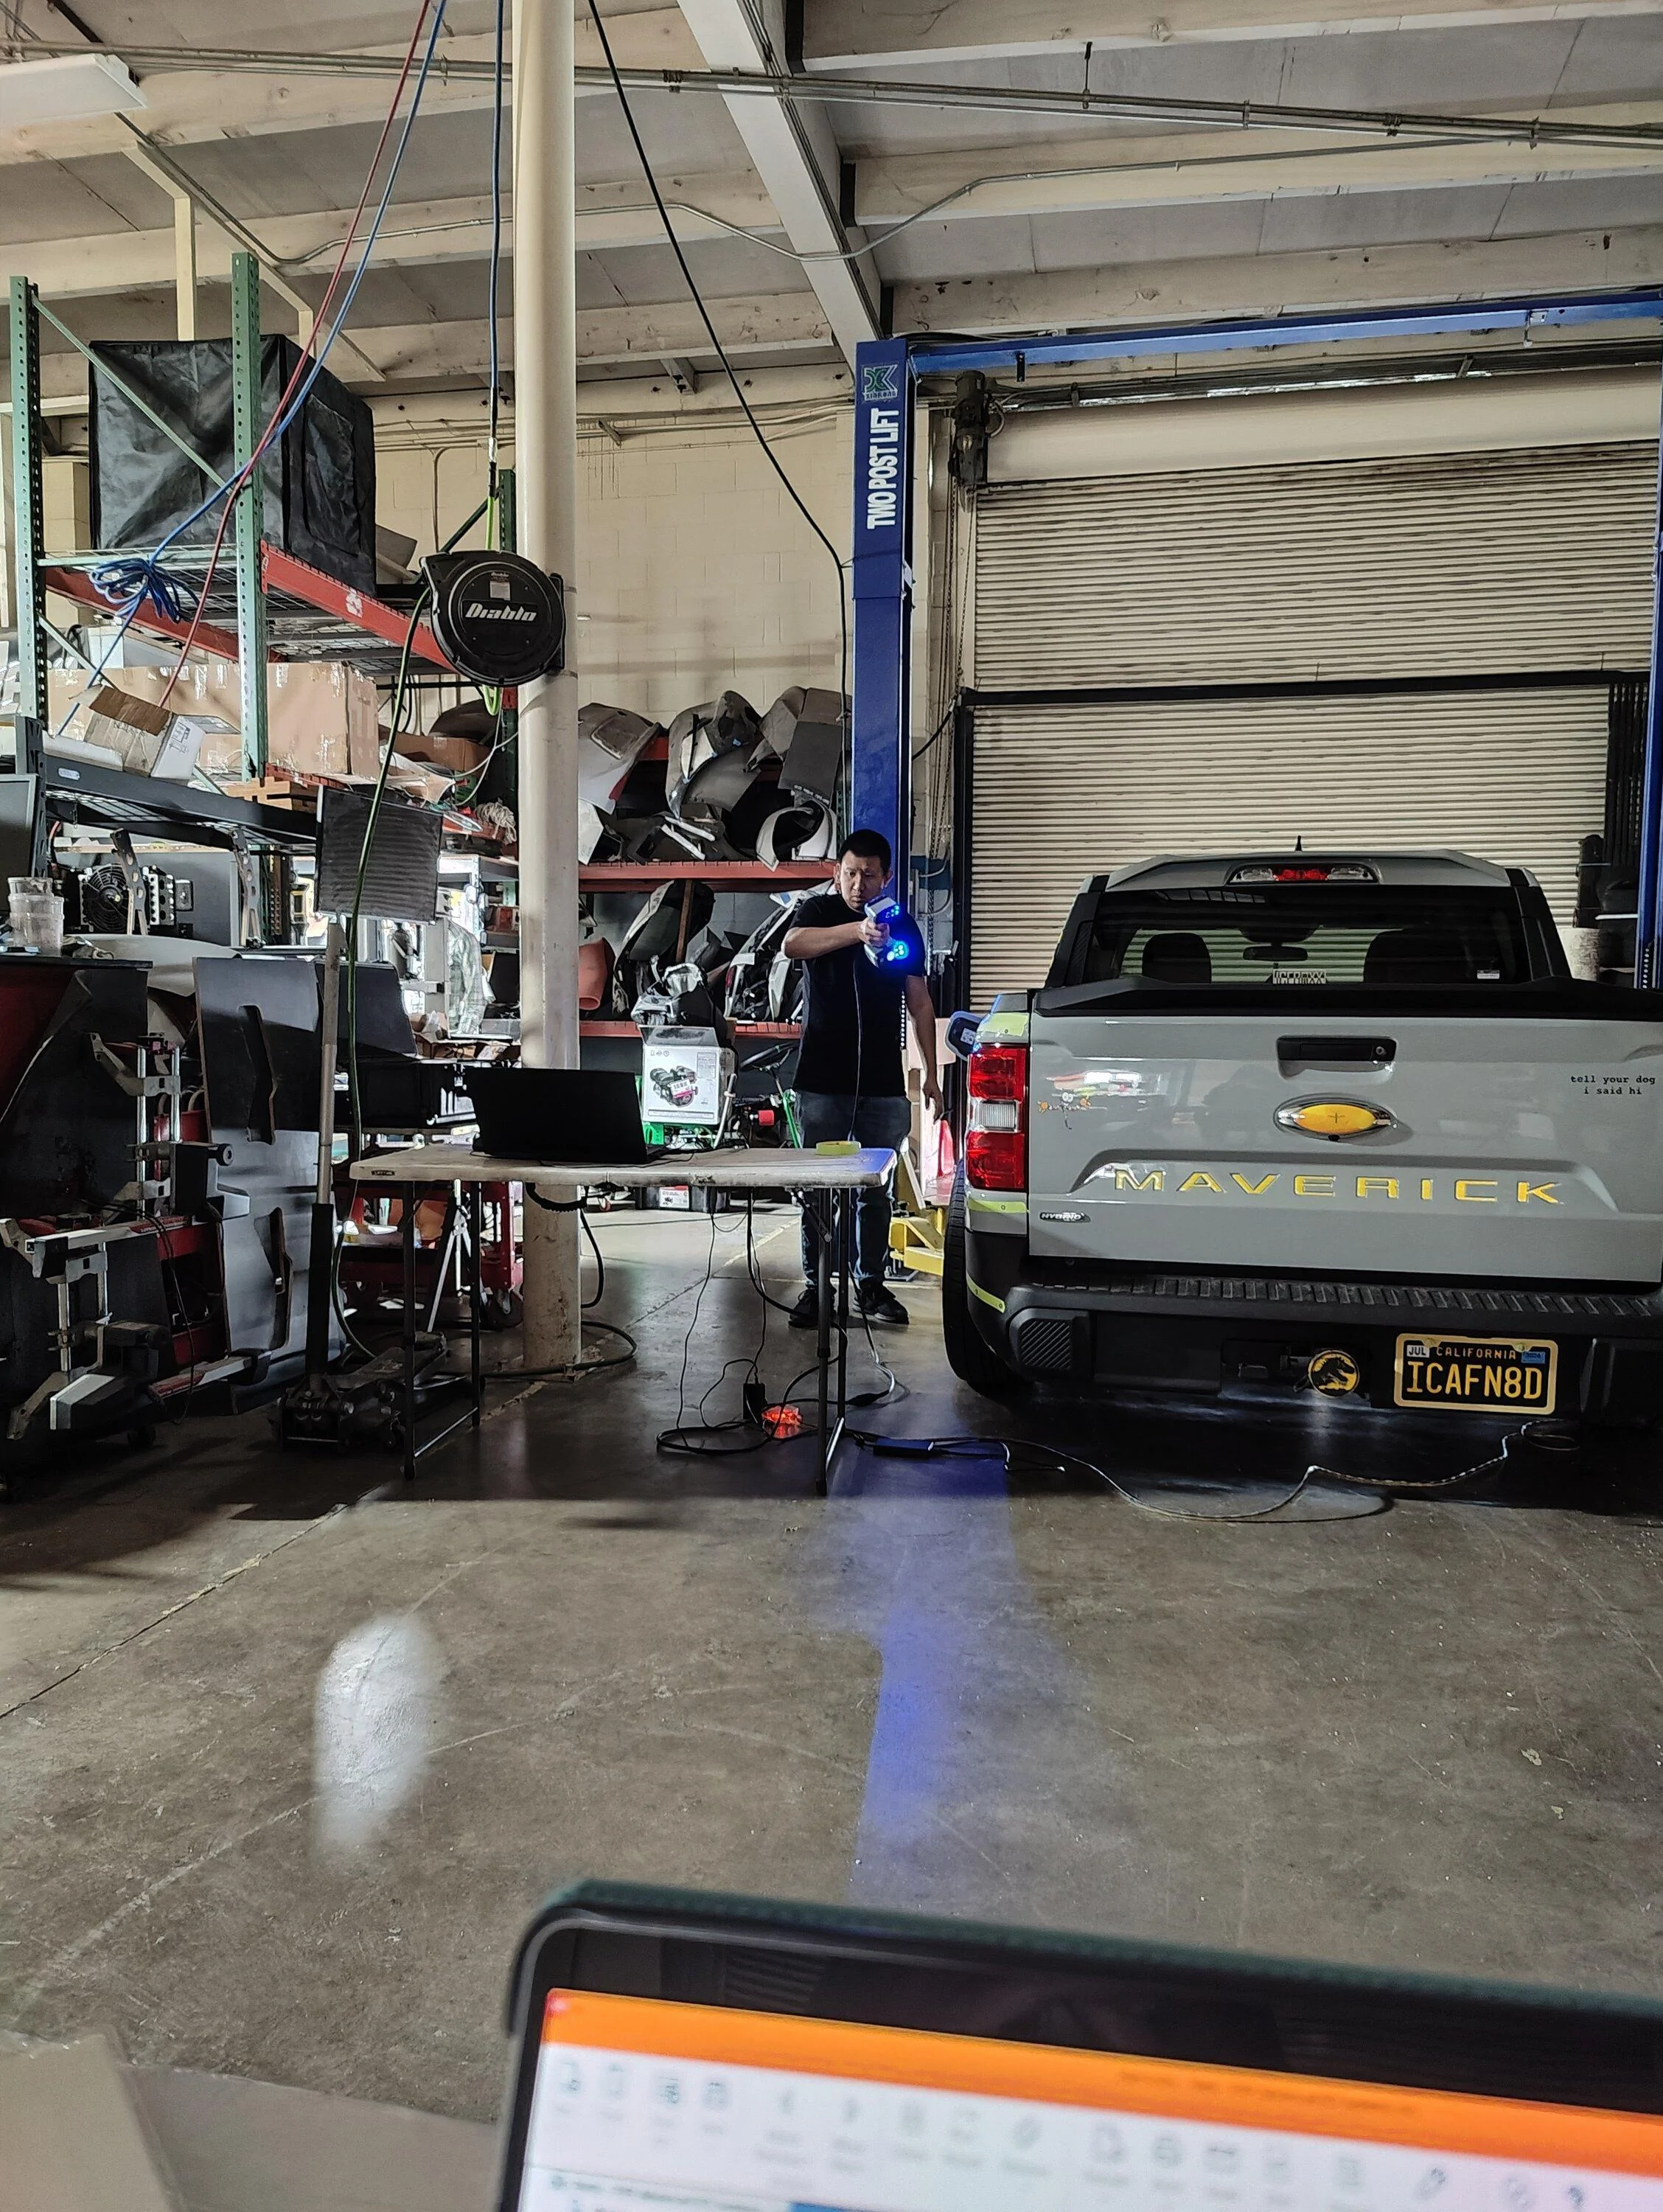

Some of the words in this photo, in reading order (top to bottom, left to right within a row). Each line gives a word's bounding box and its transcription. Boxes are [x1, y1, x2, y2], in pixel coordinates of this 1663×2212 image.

[870, 408, 899, 443] LIFT
[868, 445, 898, 490] POST
[867, 491, 897, 529] TWO
[1570, 1075, 1596, 1083] tell
[1603, 1077, 1630, 1085] your
[1636, 1075, 1656, 1085] dog
[1596, 1087, 1622, 1095] said
[1629, 1086, 1642, 1095] hi
[1114, 1169, 1563, 1205] MAVERICK
[1409, 1346, 1426, 1356] JUL
[1436, 1346, 1516, 1360] CALIFORNIA
[1406, 1361, 1542, 1399] ICAFN8D
